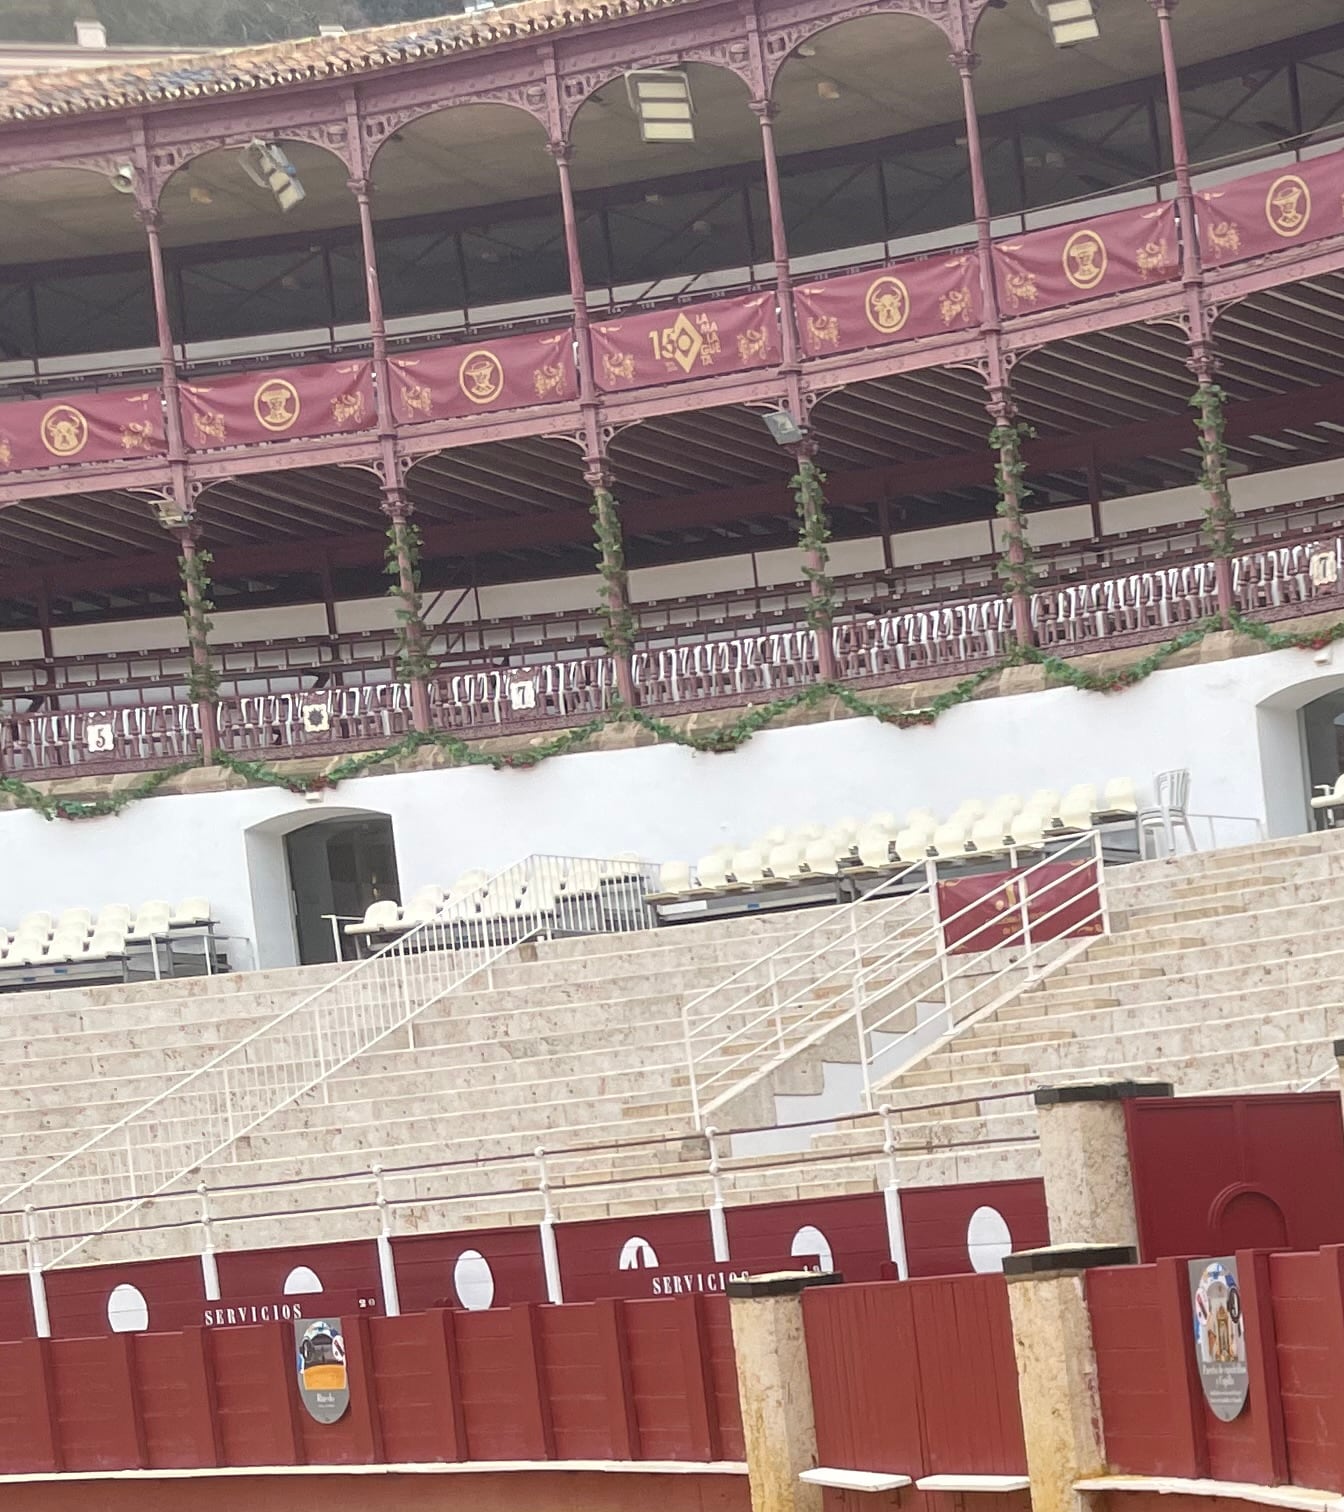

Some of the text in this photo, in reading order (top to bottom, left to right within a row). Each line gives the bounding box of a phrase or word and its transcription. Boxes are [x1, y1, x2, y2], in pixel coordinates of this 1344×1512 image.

[517, 685, 526, 706] 7
[95, 727, 106, 748] 5
[204, 1303, 302, 1326] SERVICIOS
